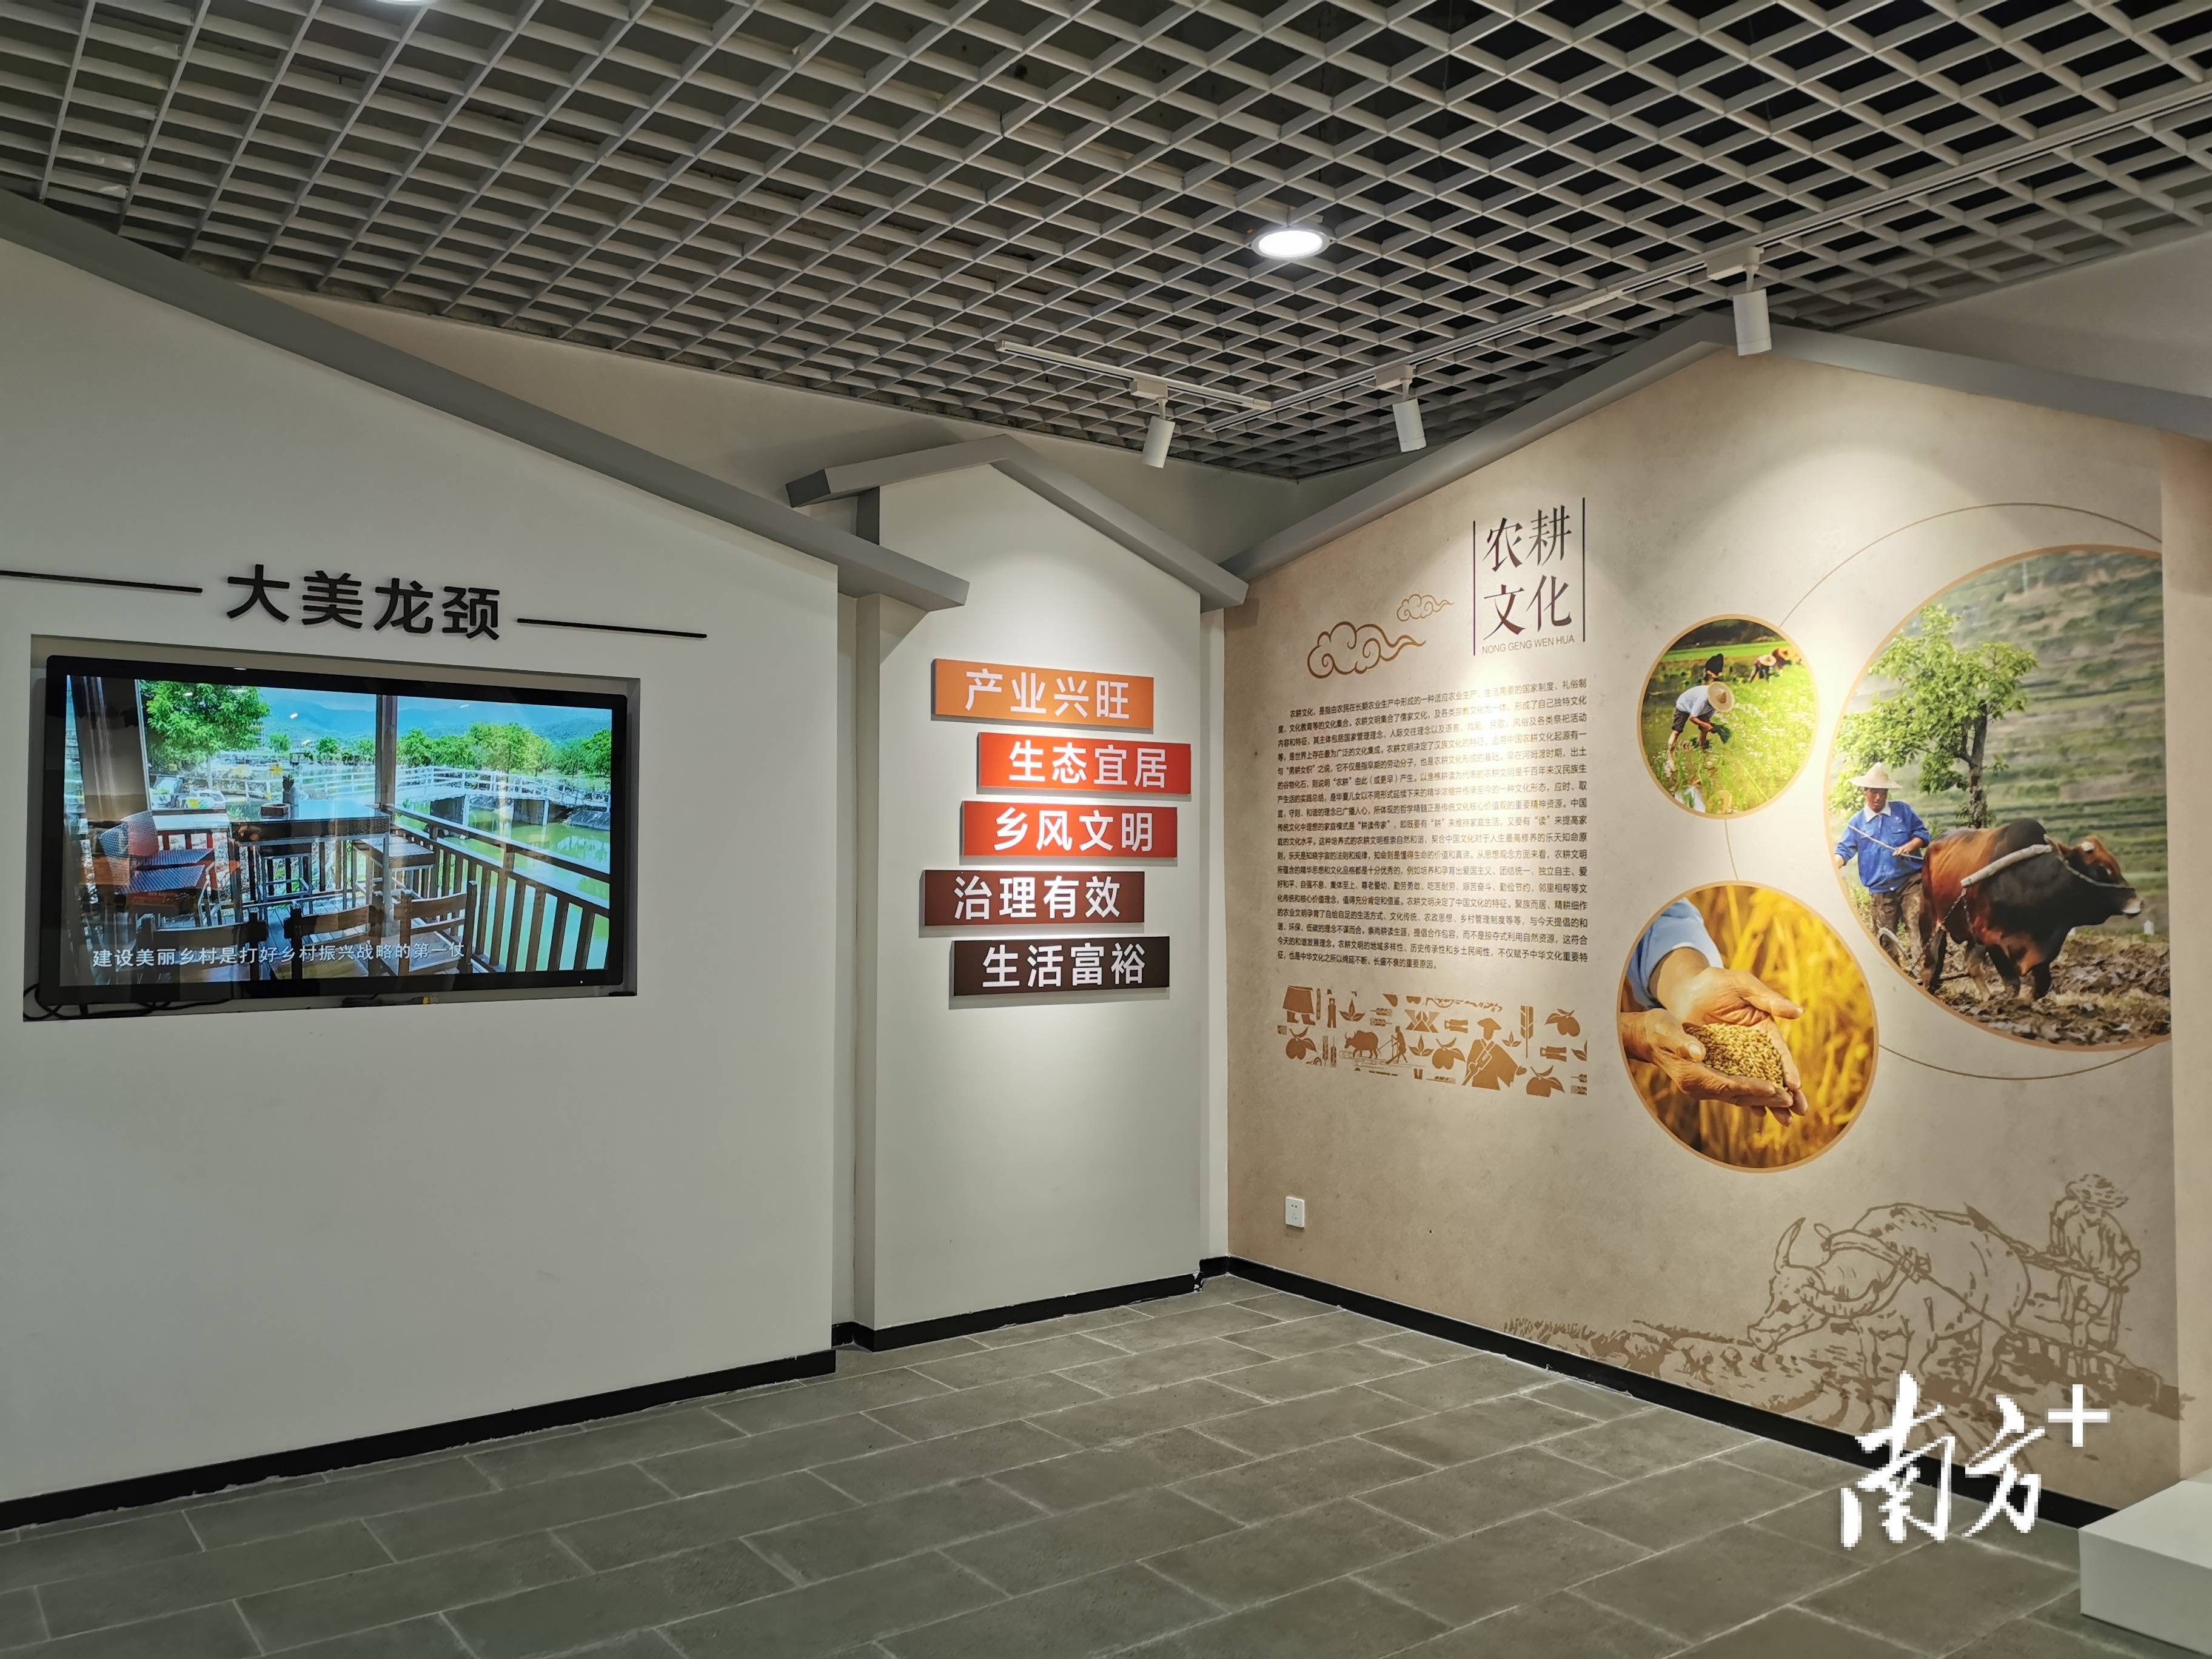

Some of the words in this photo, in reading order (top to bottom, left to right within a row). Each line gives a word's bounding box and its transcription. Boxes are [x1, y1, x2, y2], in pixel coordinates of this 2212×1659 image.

[1483, 505, 1572, 572] 农耕
[227, 564, 500, 640] 大美龙颈
[1483, 575, 1572, 640] 文化
[1482, 643, 1506, 654] NONG
[1508, 640, 1532, 651] GENG
[1533, 637, 1553, 647] WEN
[1556, 635, 1575, 645] HUA
[965, 668, 1130, 719] 产业兴旺
[1008, 739, 1167, 788] 生态宜居
[993, 806, 1153, 852] 乡风文明
[953, 875, 1121, 920] 治理有效
[92, 941, 466, 968] 建设美丽乡村是打好乡村振兴战略的第一仗
[982, 942, 1145, 988] 生活富裕
